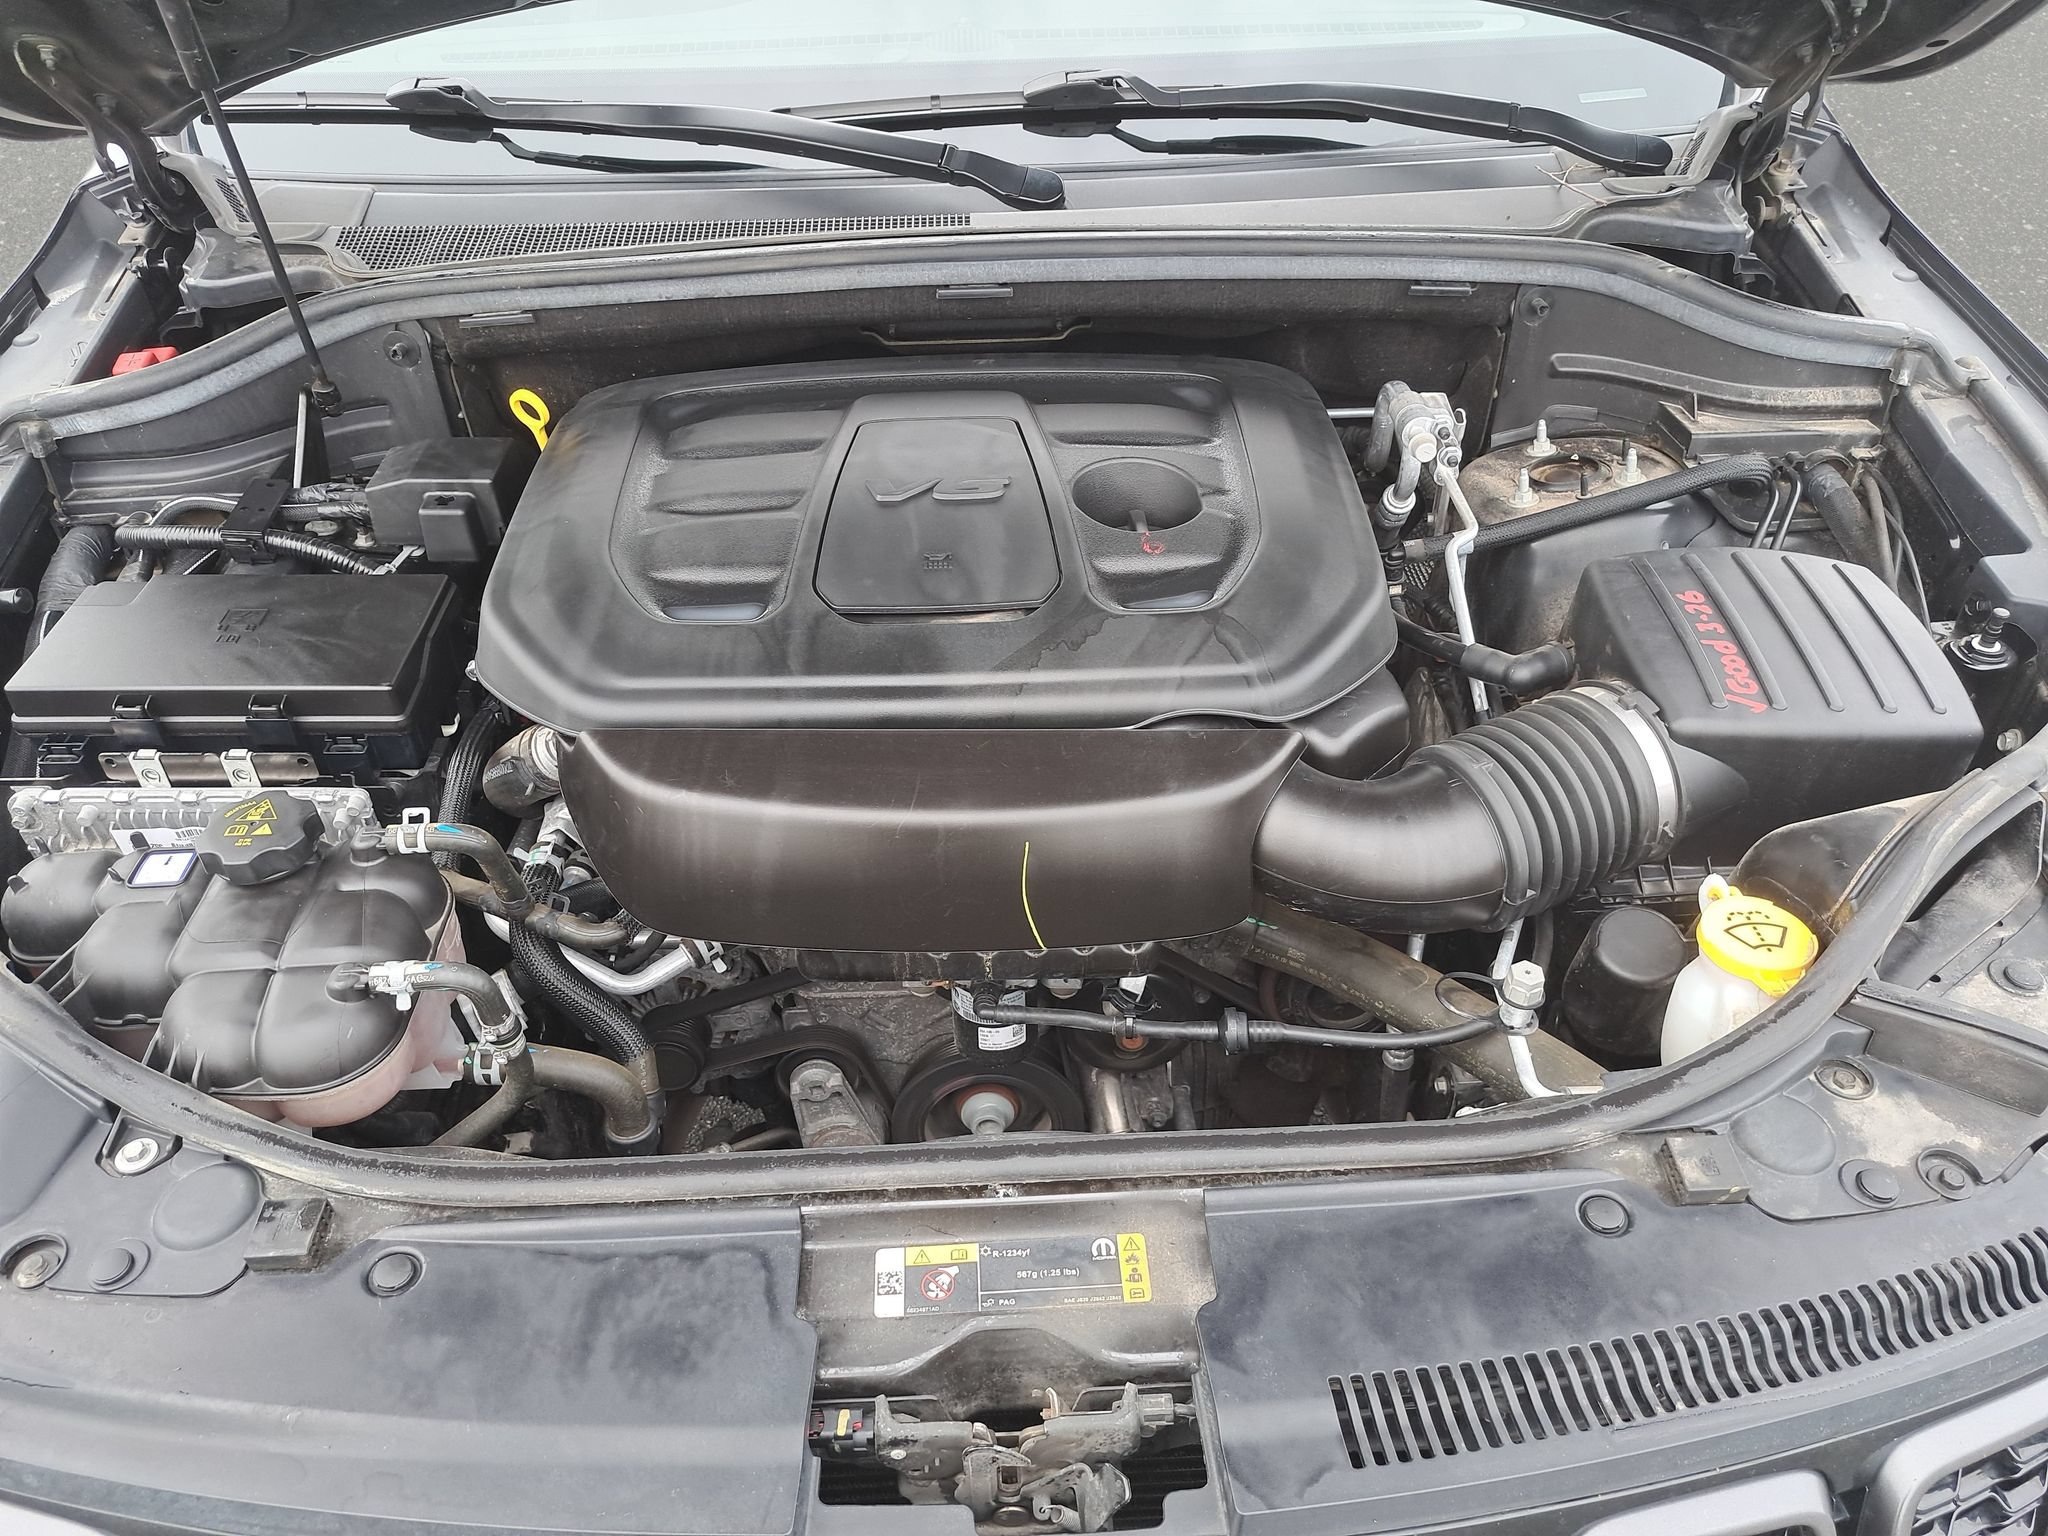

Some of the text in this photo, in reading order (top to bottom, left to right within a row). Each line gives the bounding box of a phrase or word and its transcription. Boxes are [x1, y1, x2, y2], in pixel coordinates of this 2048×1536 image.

[1699, 639, 1759, 695] Good
[992, 1247, 1031, 1258] R-1234yf
[1016, 1268, 1080, 1280] 567g (1.25 lbs)
[998, 1298, 1016, 1306] PAG
